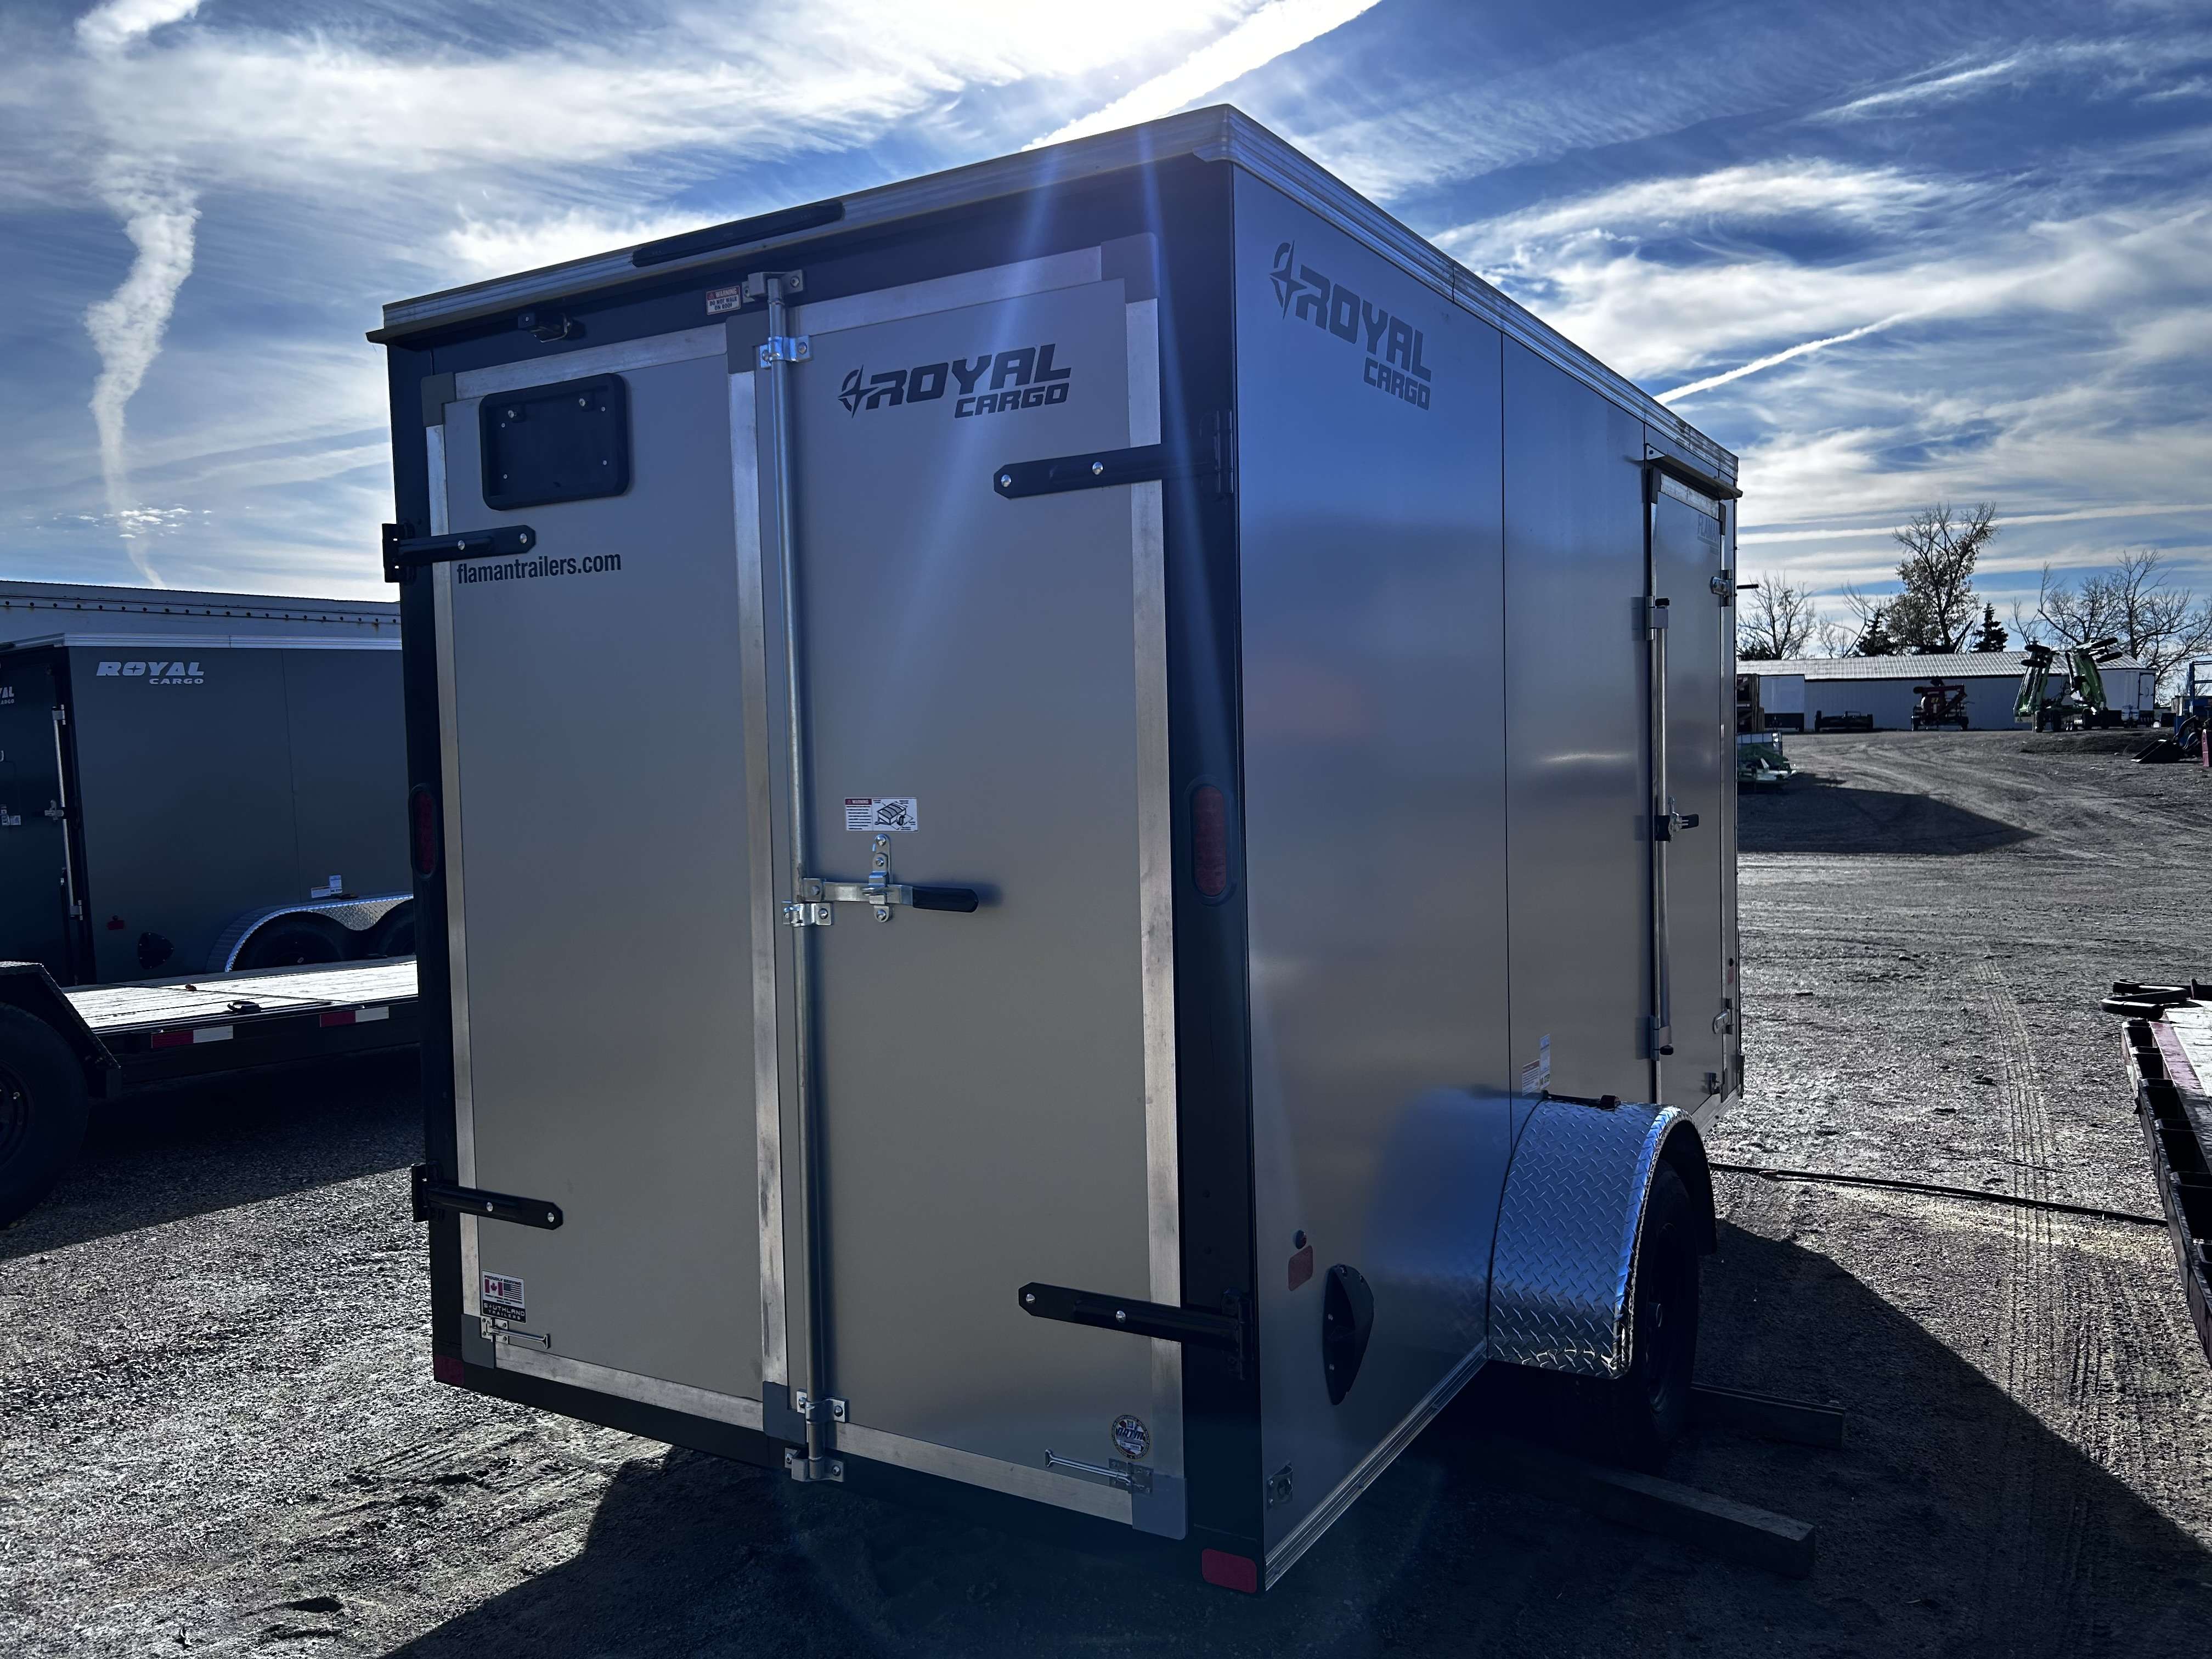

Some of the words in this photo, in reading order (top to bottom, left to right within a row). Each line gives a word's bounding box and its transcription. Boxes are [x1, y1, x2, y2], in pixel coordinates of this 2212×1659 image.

[1295, 264, 1431, 382] ROYAL
[865, 343, 1071, 410] ROYAL
[1363, 357, 1430, 411] CARGO
[954, 382, 1070, 419] CARGO
[456, 554, 622, 584] flamantrailers.com
[96, 662, 205, 676] ROYAL
[488, 1309, 521, 1320] TRAILERS
